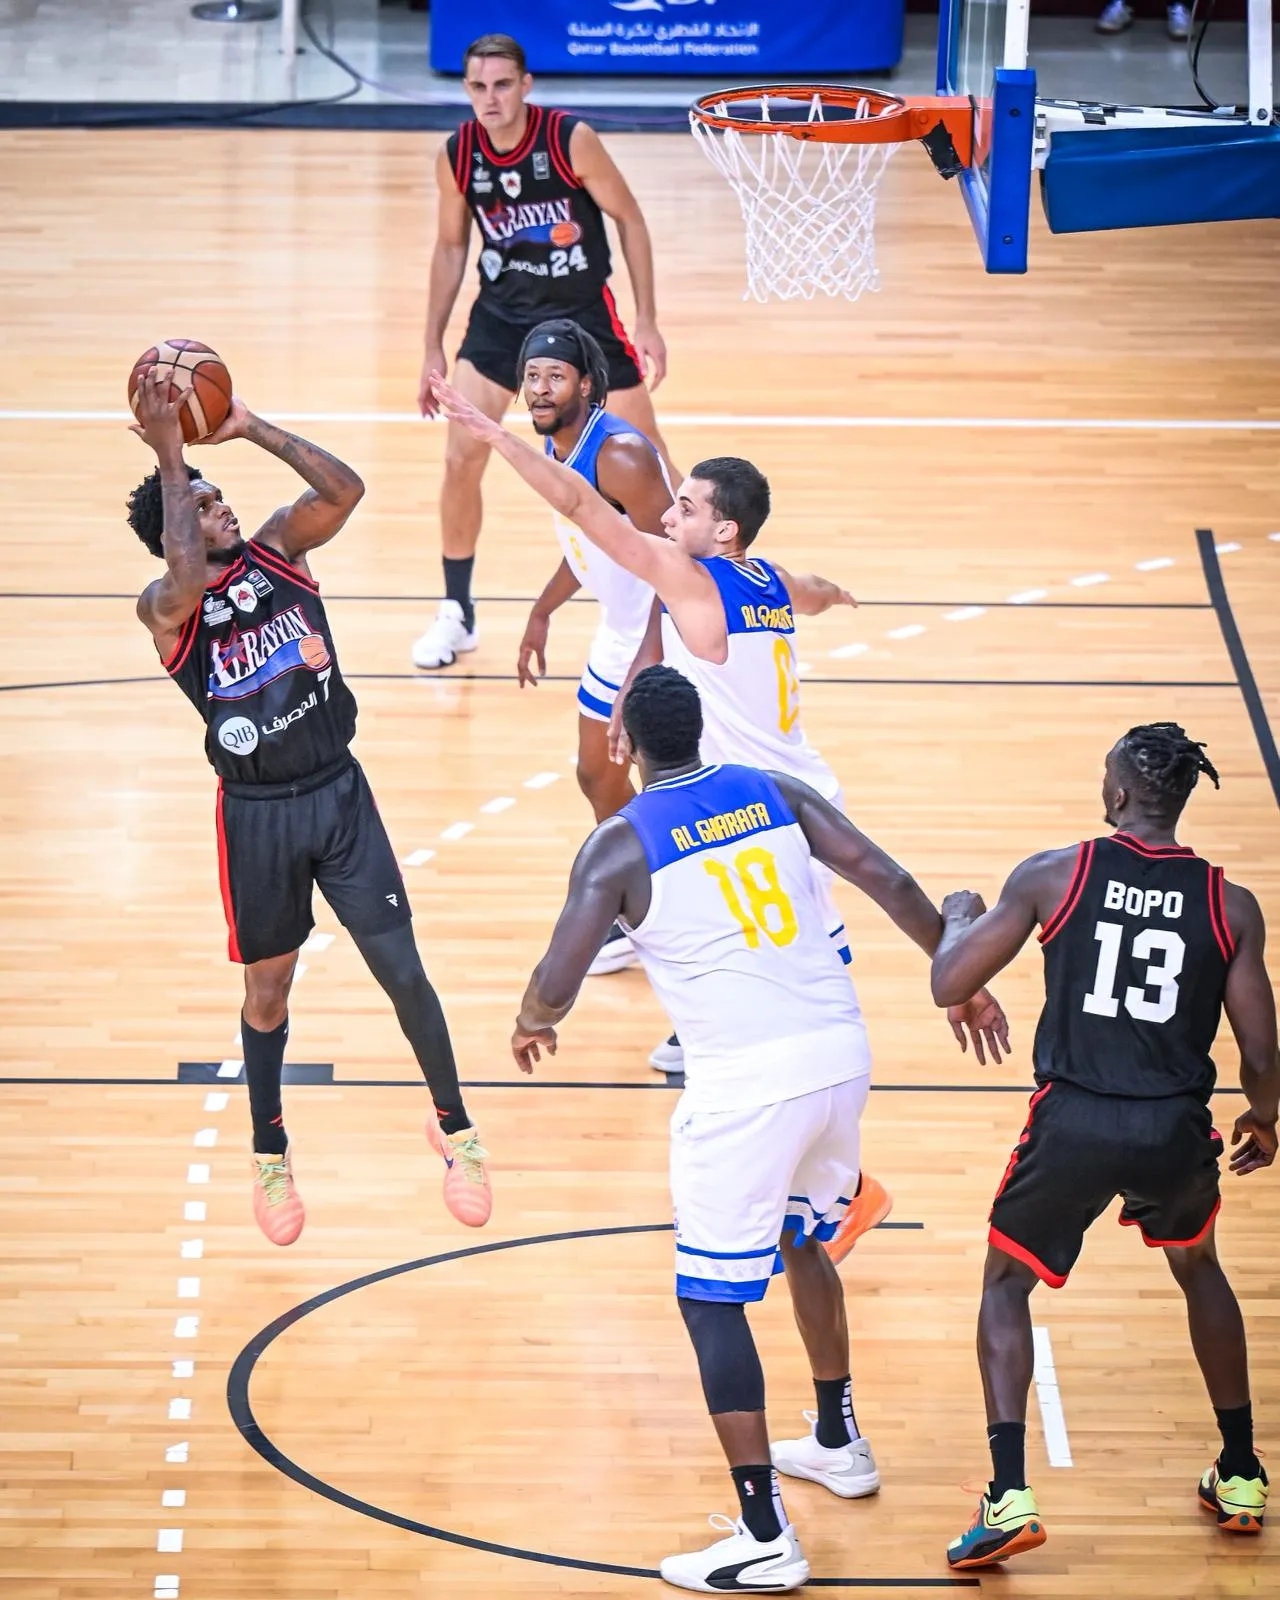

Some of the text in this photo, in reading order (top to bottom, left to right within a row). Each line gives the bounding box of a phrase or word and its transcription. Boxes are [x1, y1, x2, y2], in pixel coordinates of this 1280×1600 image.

[567, 42, 759, 56] Qatar Basketball Federation
[550, 245, 588, 278] 24
[741, 605, 761, 628] AL
[316, 666, 332, 702] 7
[261, 691, 317, 735] المصرف
[222, 725, 255, 748] QIB
[670, 802, 771, 852] AL GHARAFA
[702, 846, 799, 950] 18
[1104, 880, 1184, 919] BOPO
[1082, 921, 1187, 1024] 13
